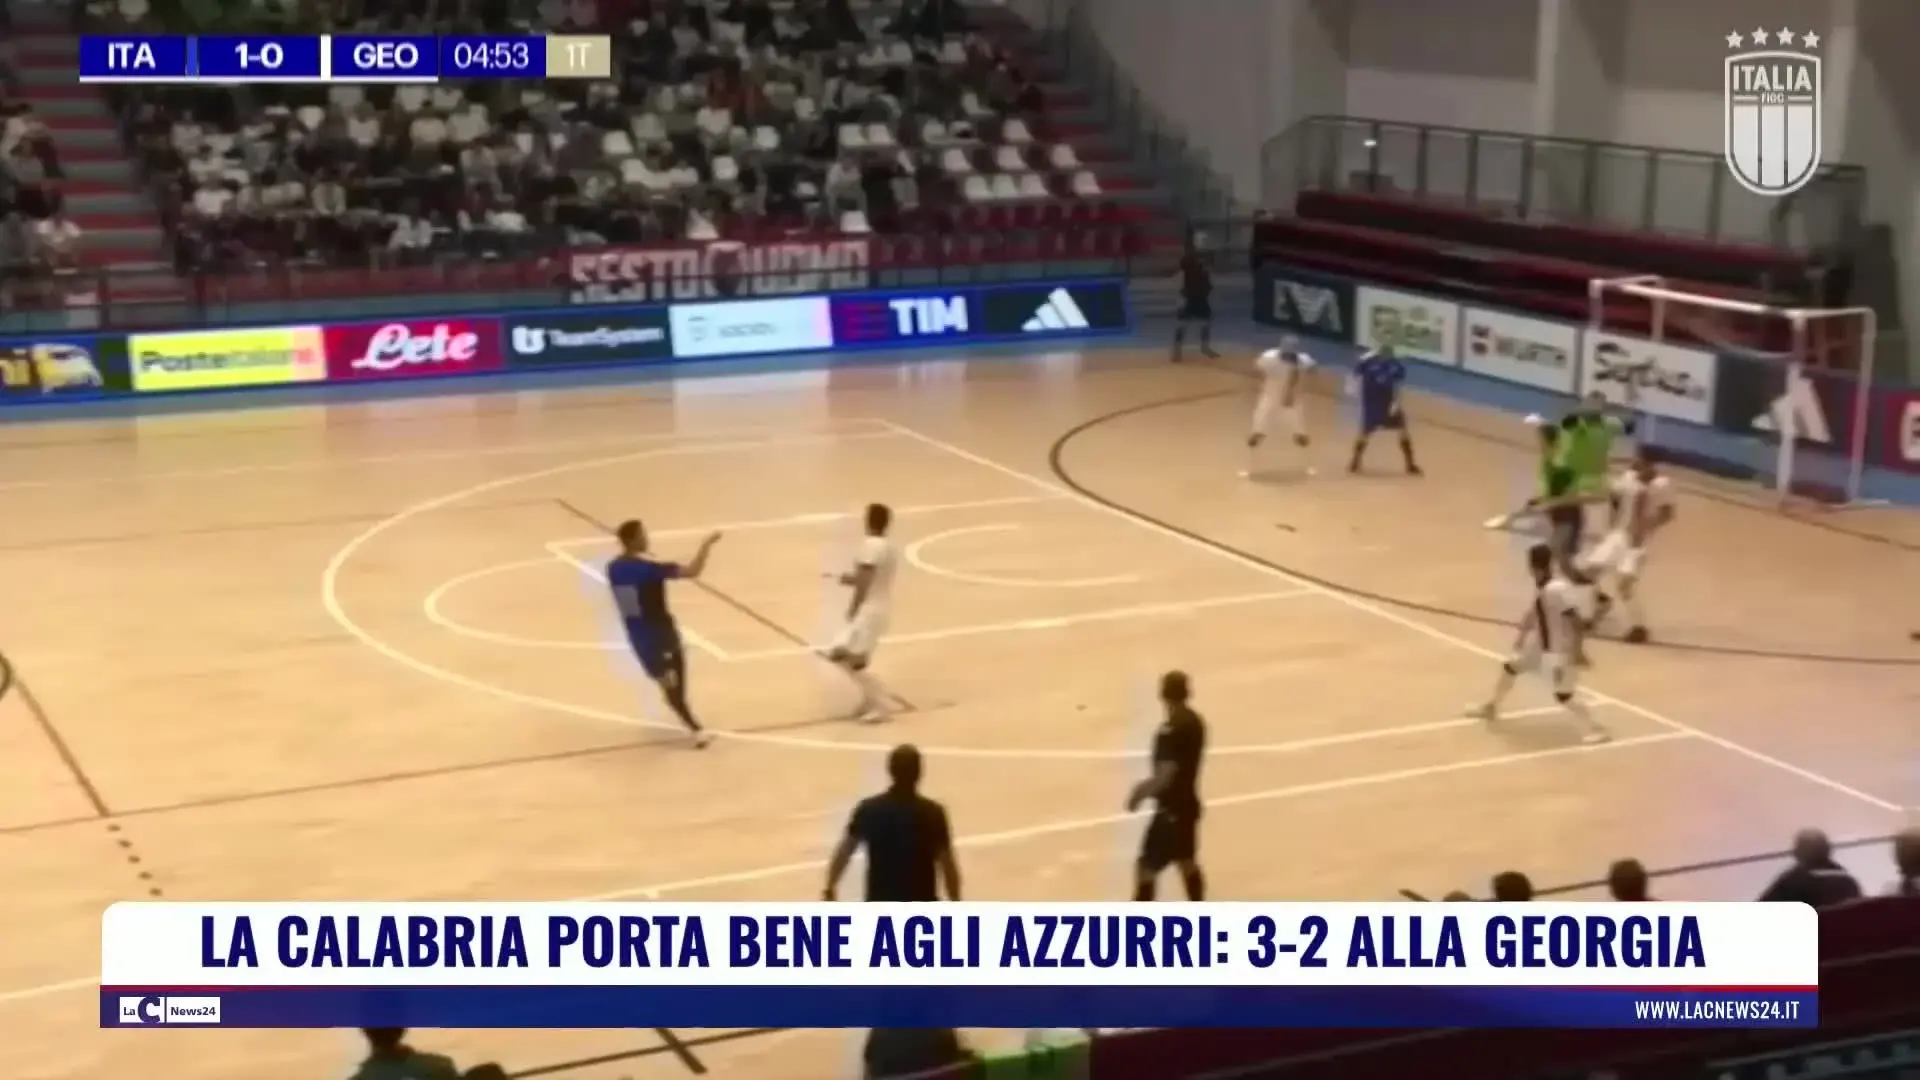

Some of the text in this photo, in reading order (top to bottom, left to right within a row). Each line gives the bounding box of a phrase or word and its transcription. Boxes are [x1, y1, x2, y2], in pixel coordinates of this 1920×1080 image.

[571, 249, 699, 304] SESTO
[888, 296, 969, 336] TIM
[351, 322, 479, 370] Lete
